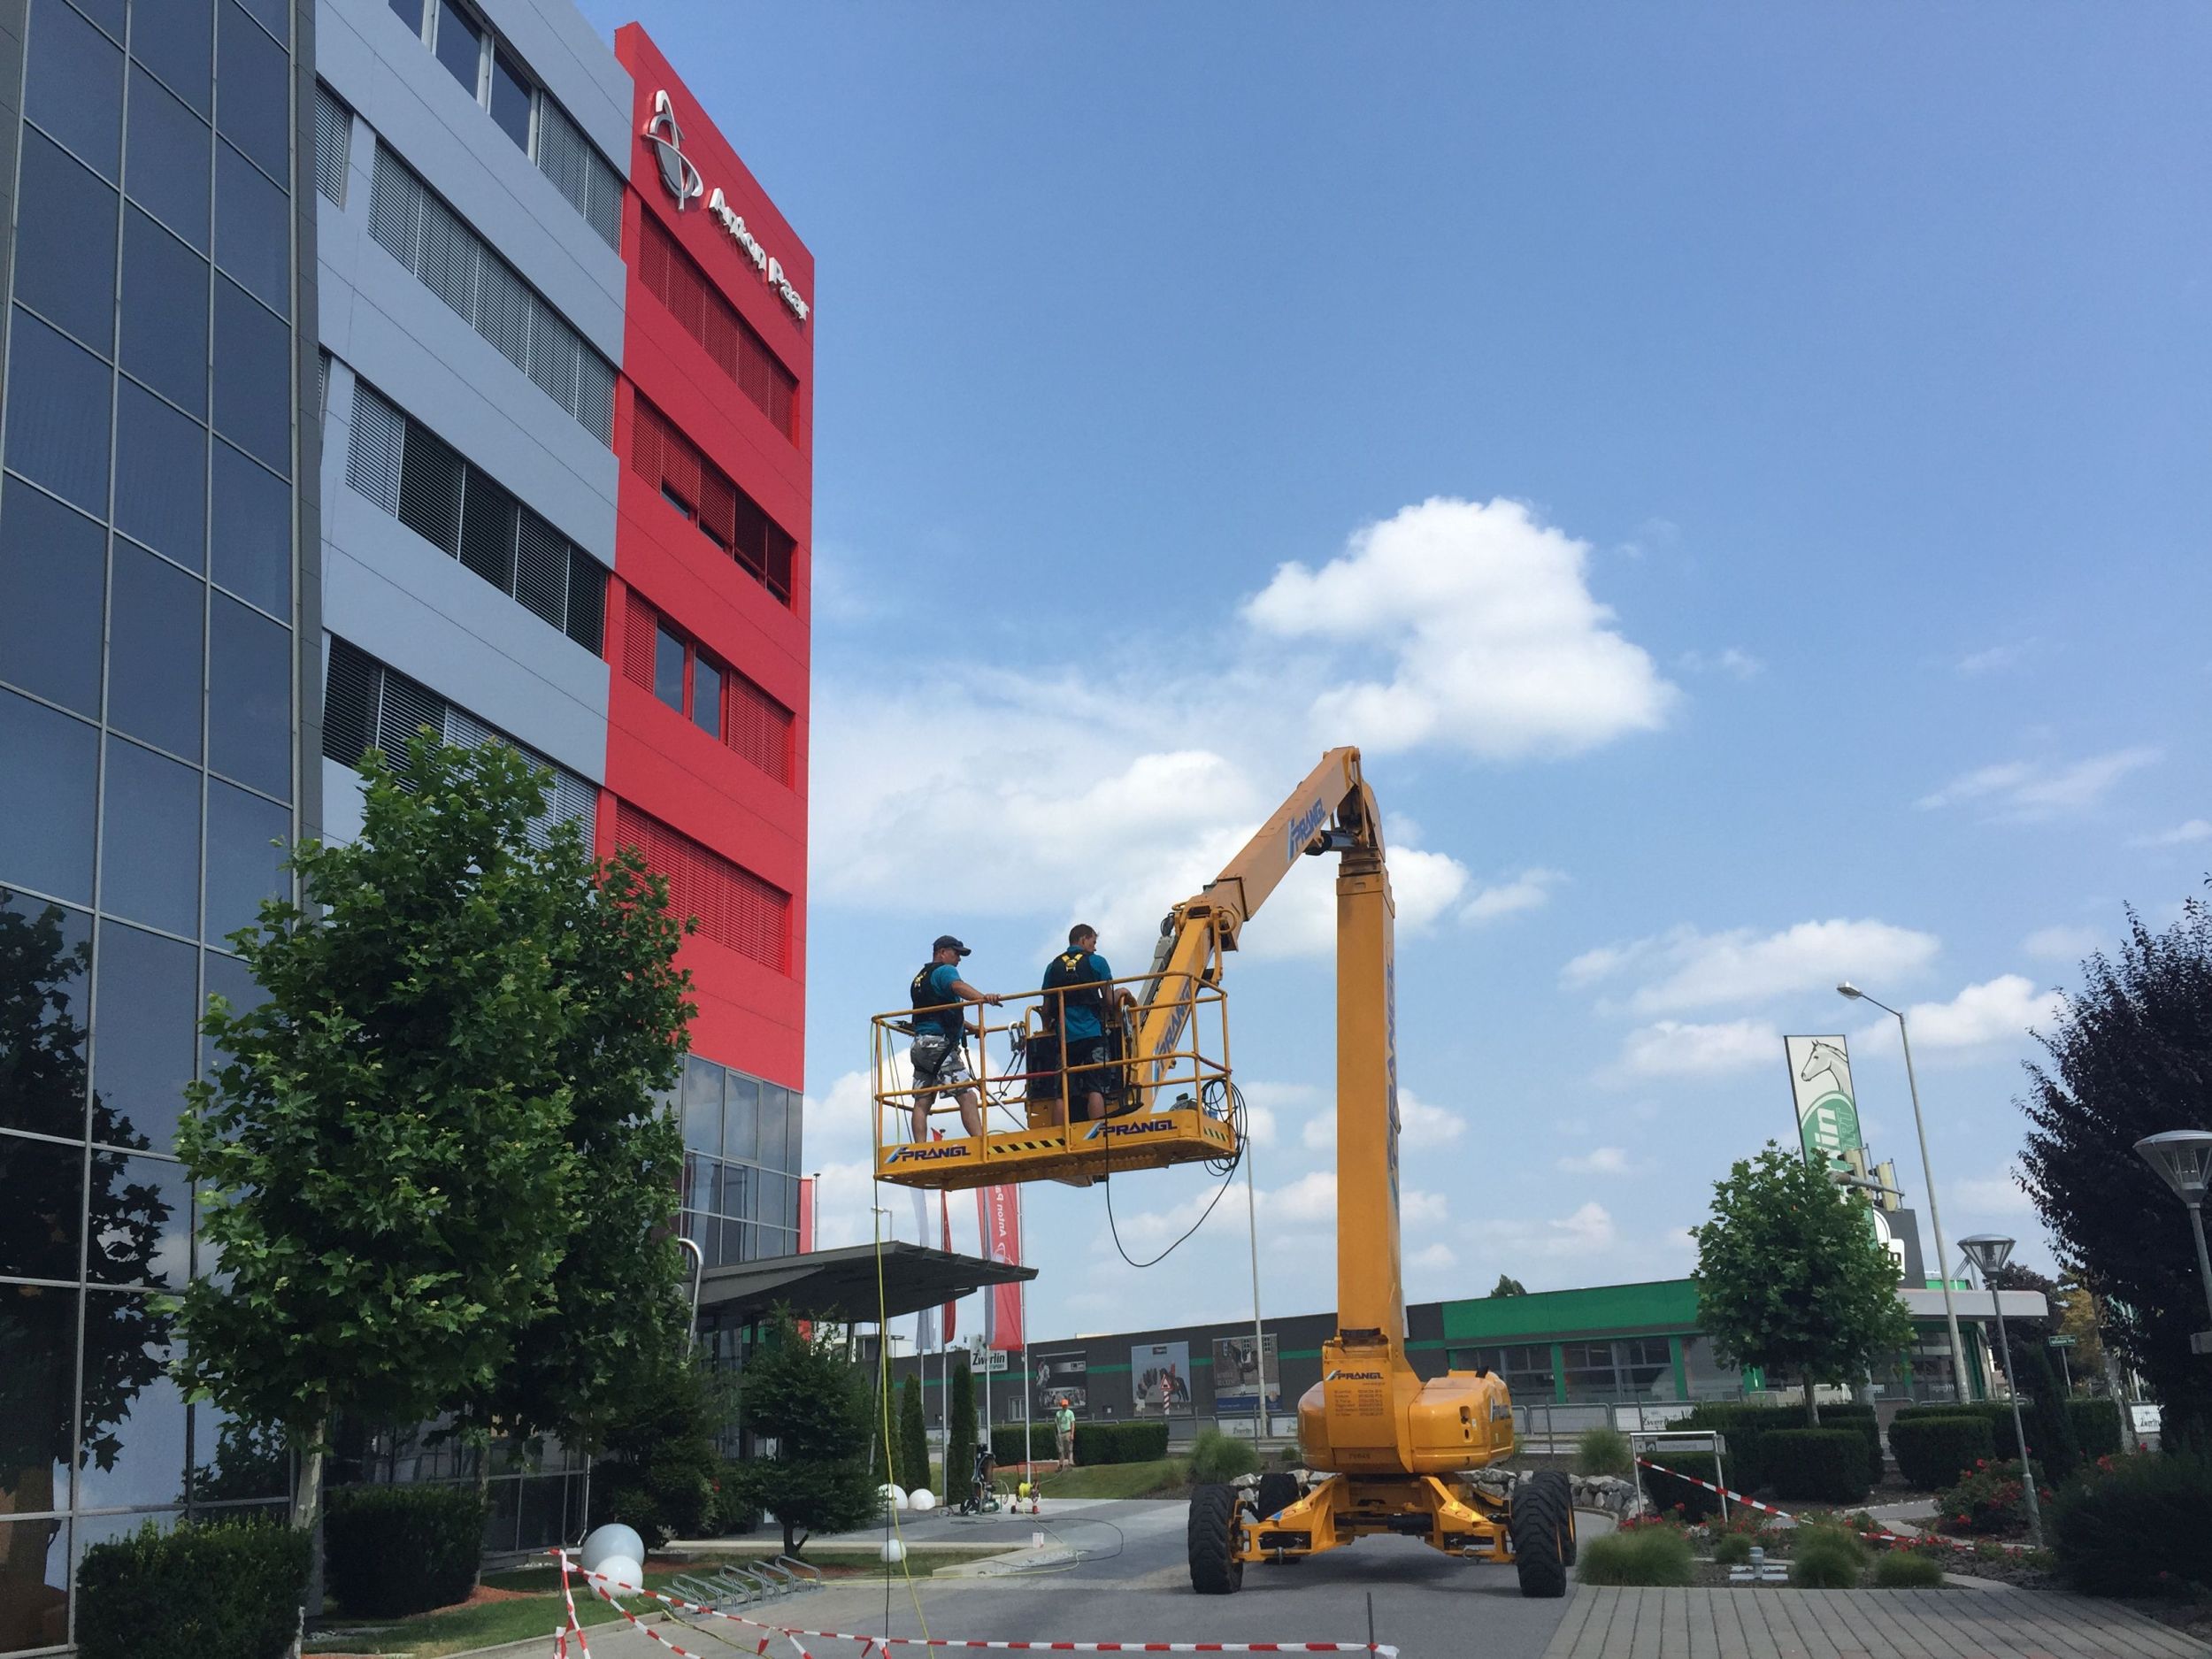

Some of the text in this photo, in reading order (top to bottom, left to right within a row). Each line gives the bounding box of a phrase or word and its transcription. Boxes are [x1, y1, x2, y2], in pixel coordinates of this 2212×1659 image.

[709, 187, 810, 321] Anton Paar
[1290, 798, 1326, 852] PRANGL
[1101, 1119, 1178, 1136] PRANGL
[902, 1145, 972, 1162] PRANGL
[972, 1351, 1005, 1366] Zwrlin
[1337, 1371, 1384, 1380] PRANGL
